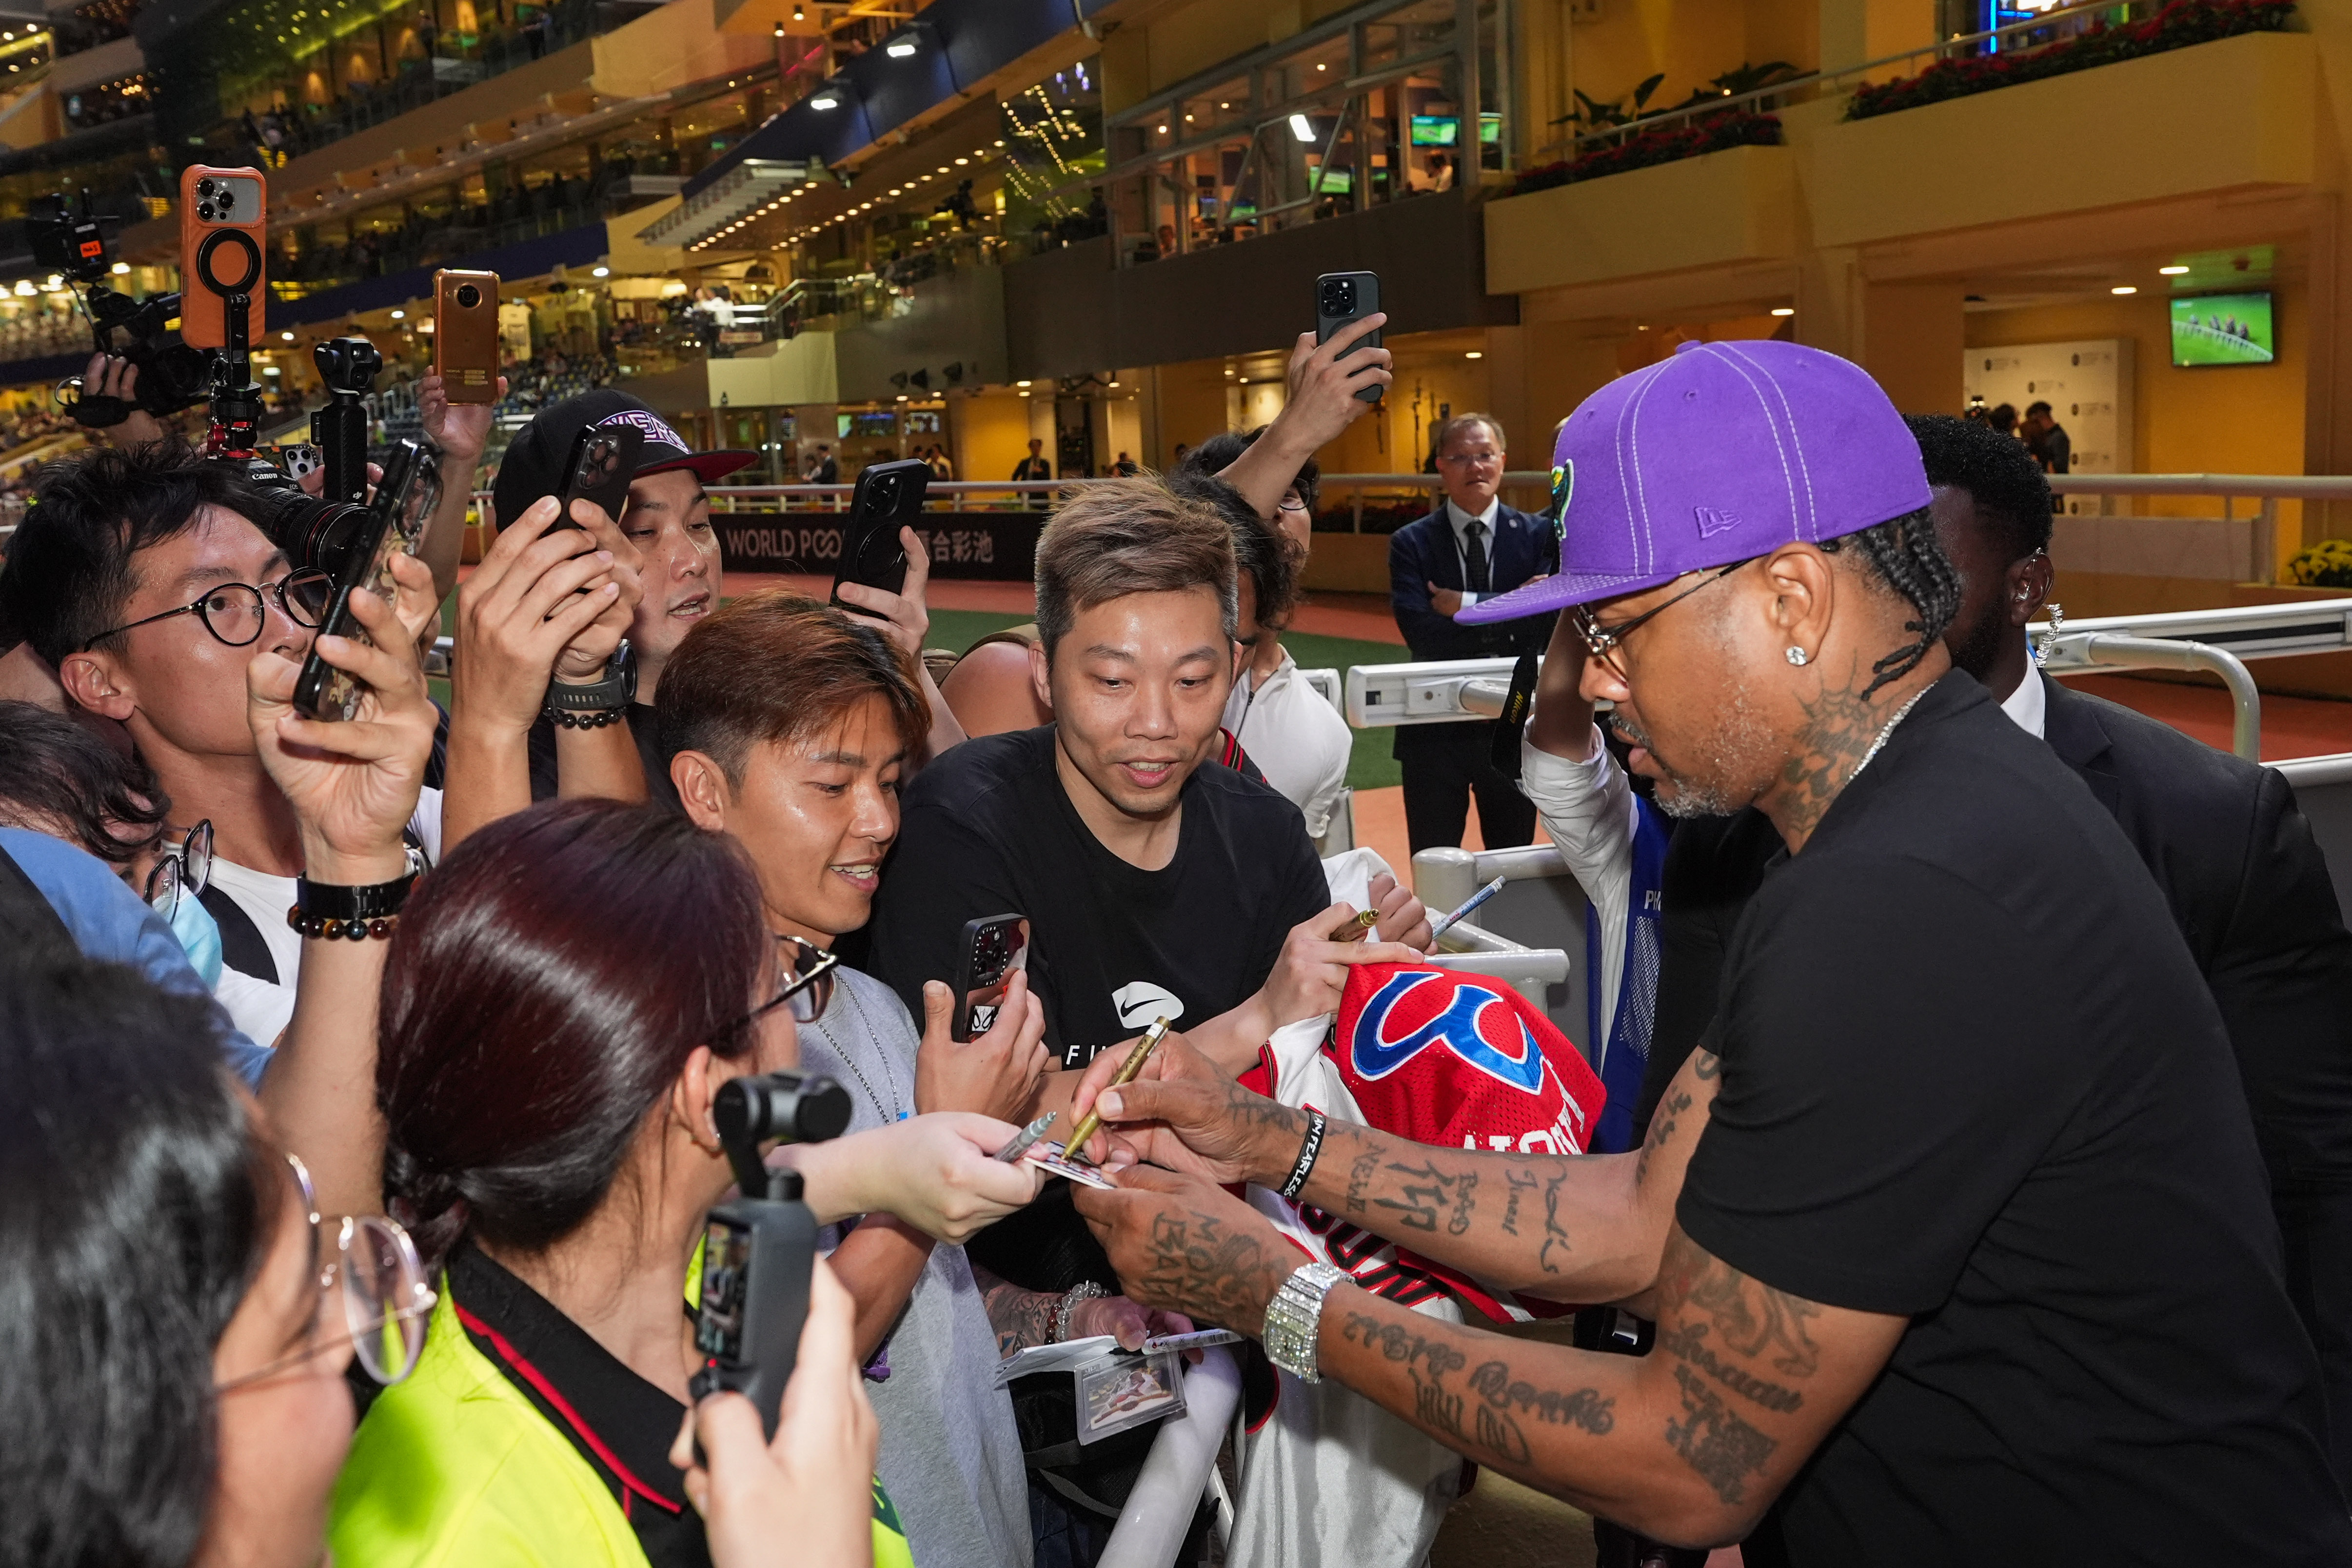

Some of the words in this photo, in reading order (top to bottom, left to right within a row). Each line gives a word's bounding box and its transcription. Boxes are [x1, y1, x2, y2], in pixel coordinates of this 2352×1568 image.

[726, 529, 796, 557] WORLD
[800, 528, 842, 559] POO
[1510, 691, 1524, 724] Nikon
[1311, 1117, 1324, 1136] AM
[1284, 1135, 1319, 1197] FEARLESS
